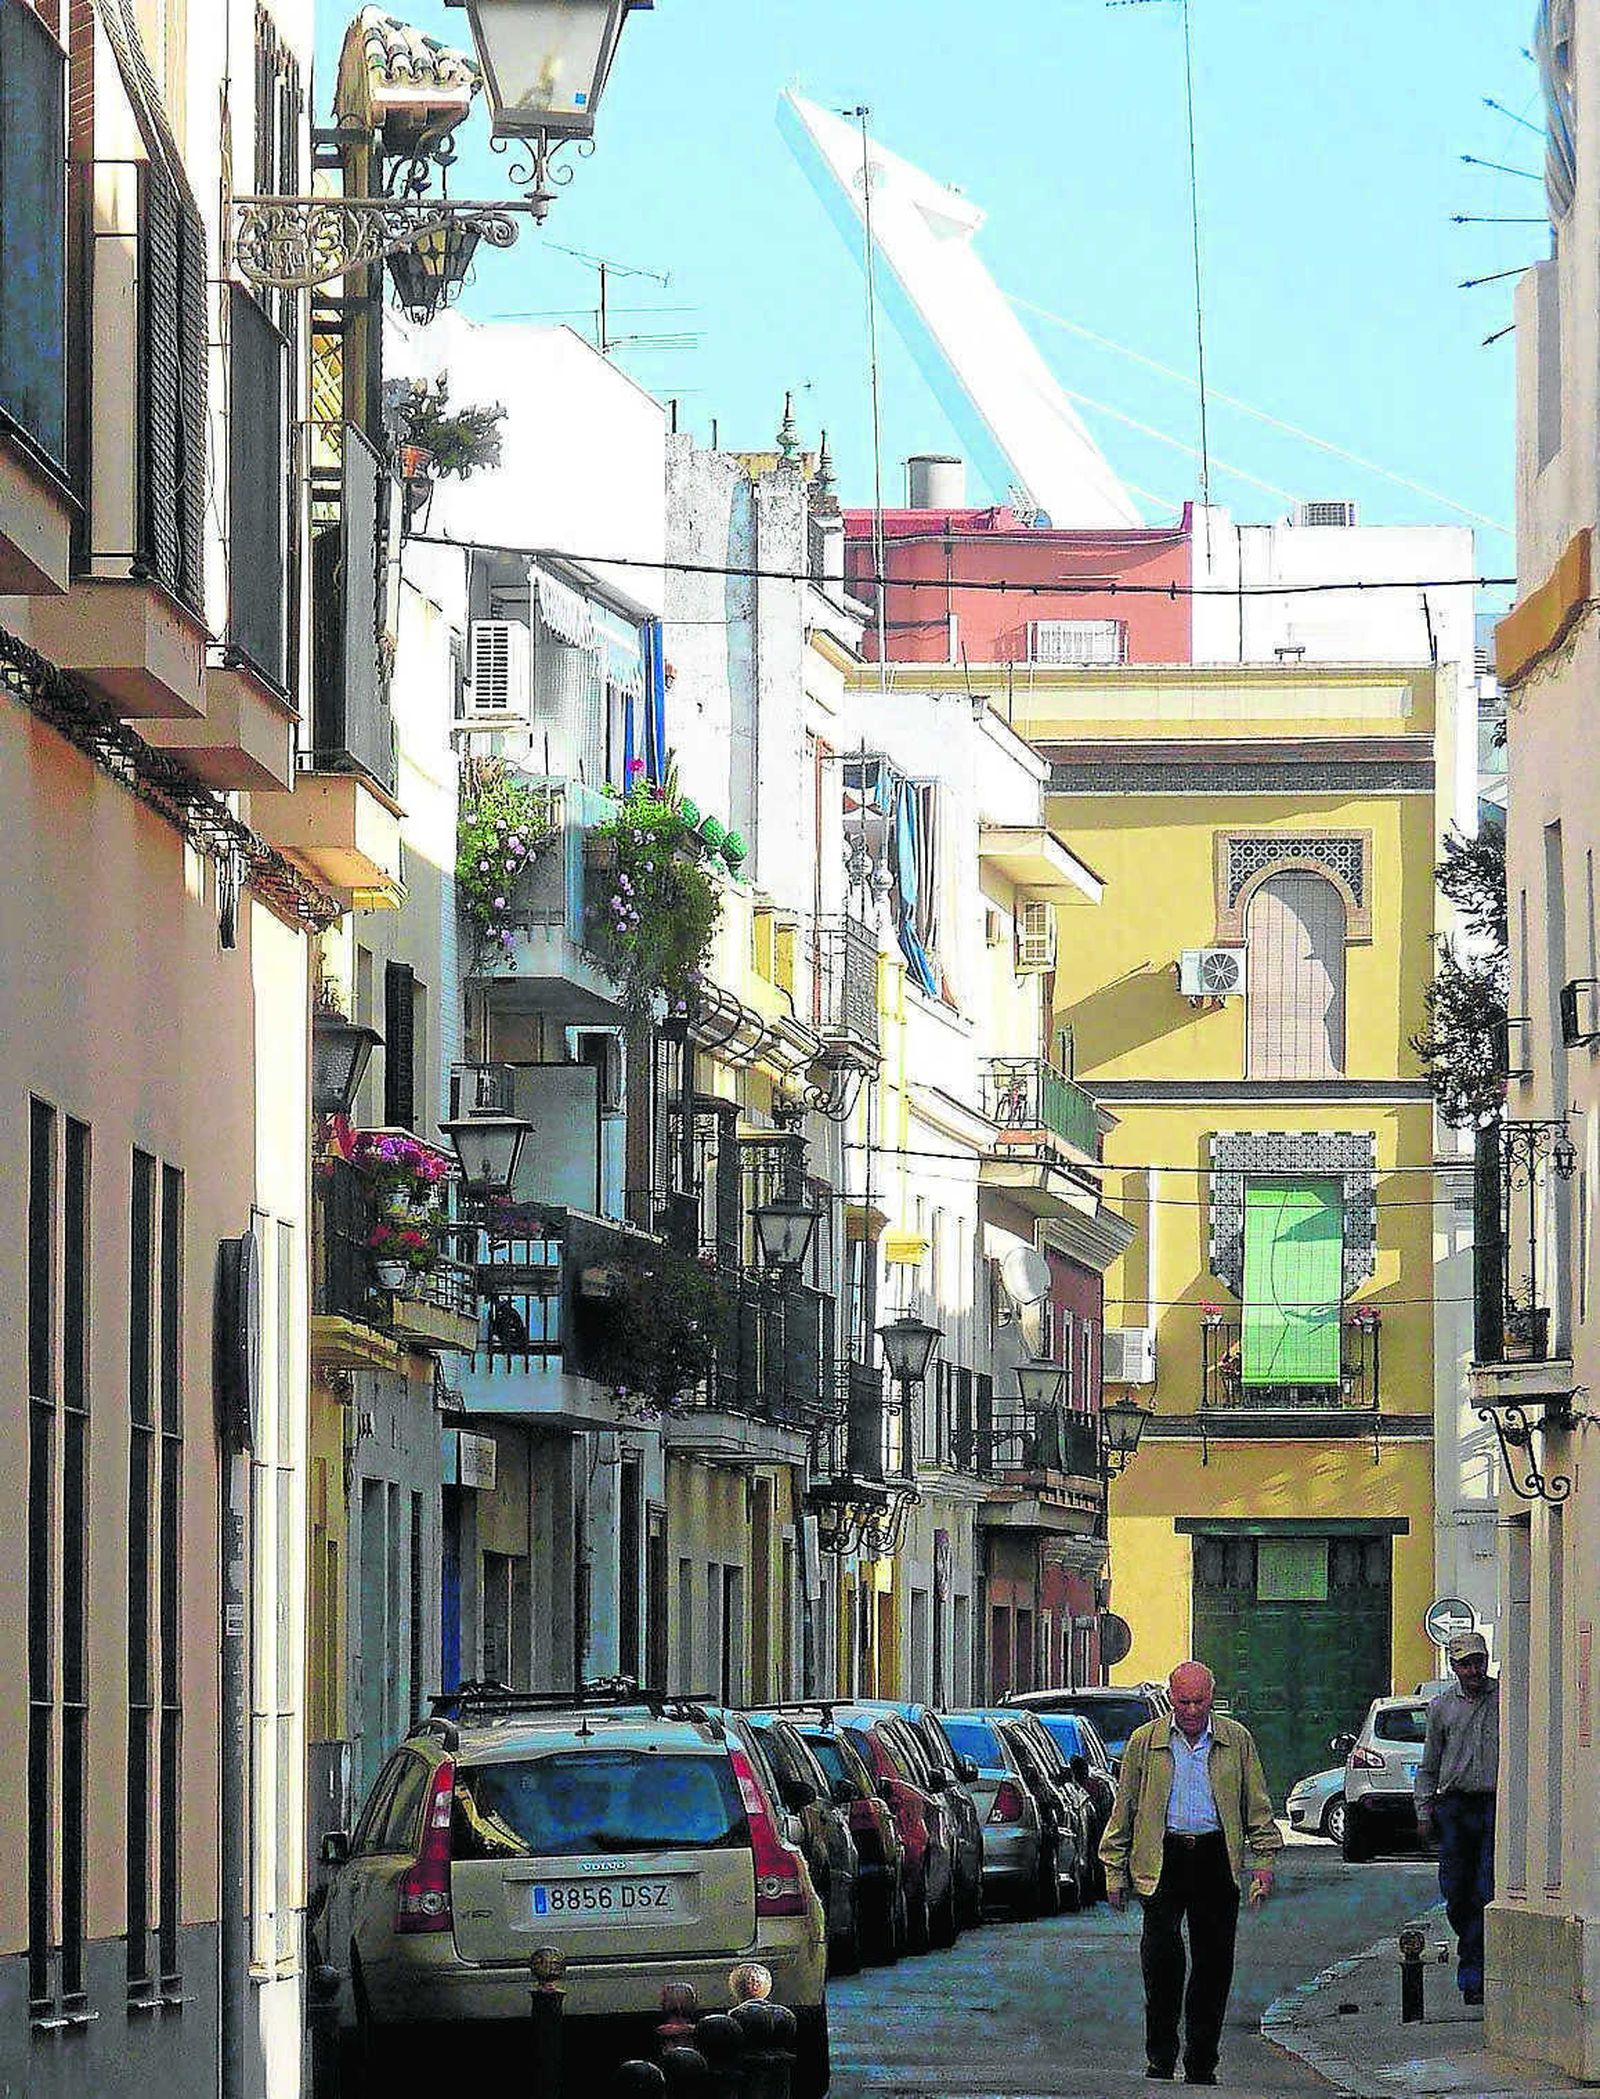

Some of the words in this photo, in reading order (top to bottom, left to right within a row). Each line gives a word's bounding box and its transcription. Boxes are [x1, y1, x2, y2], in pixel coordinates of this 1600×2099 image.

[582, 1861, 627, 1872] VOLVO
[551, 1887, 612, 1910] 8856
[621, 1885, 668, 1908] DSZ
